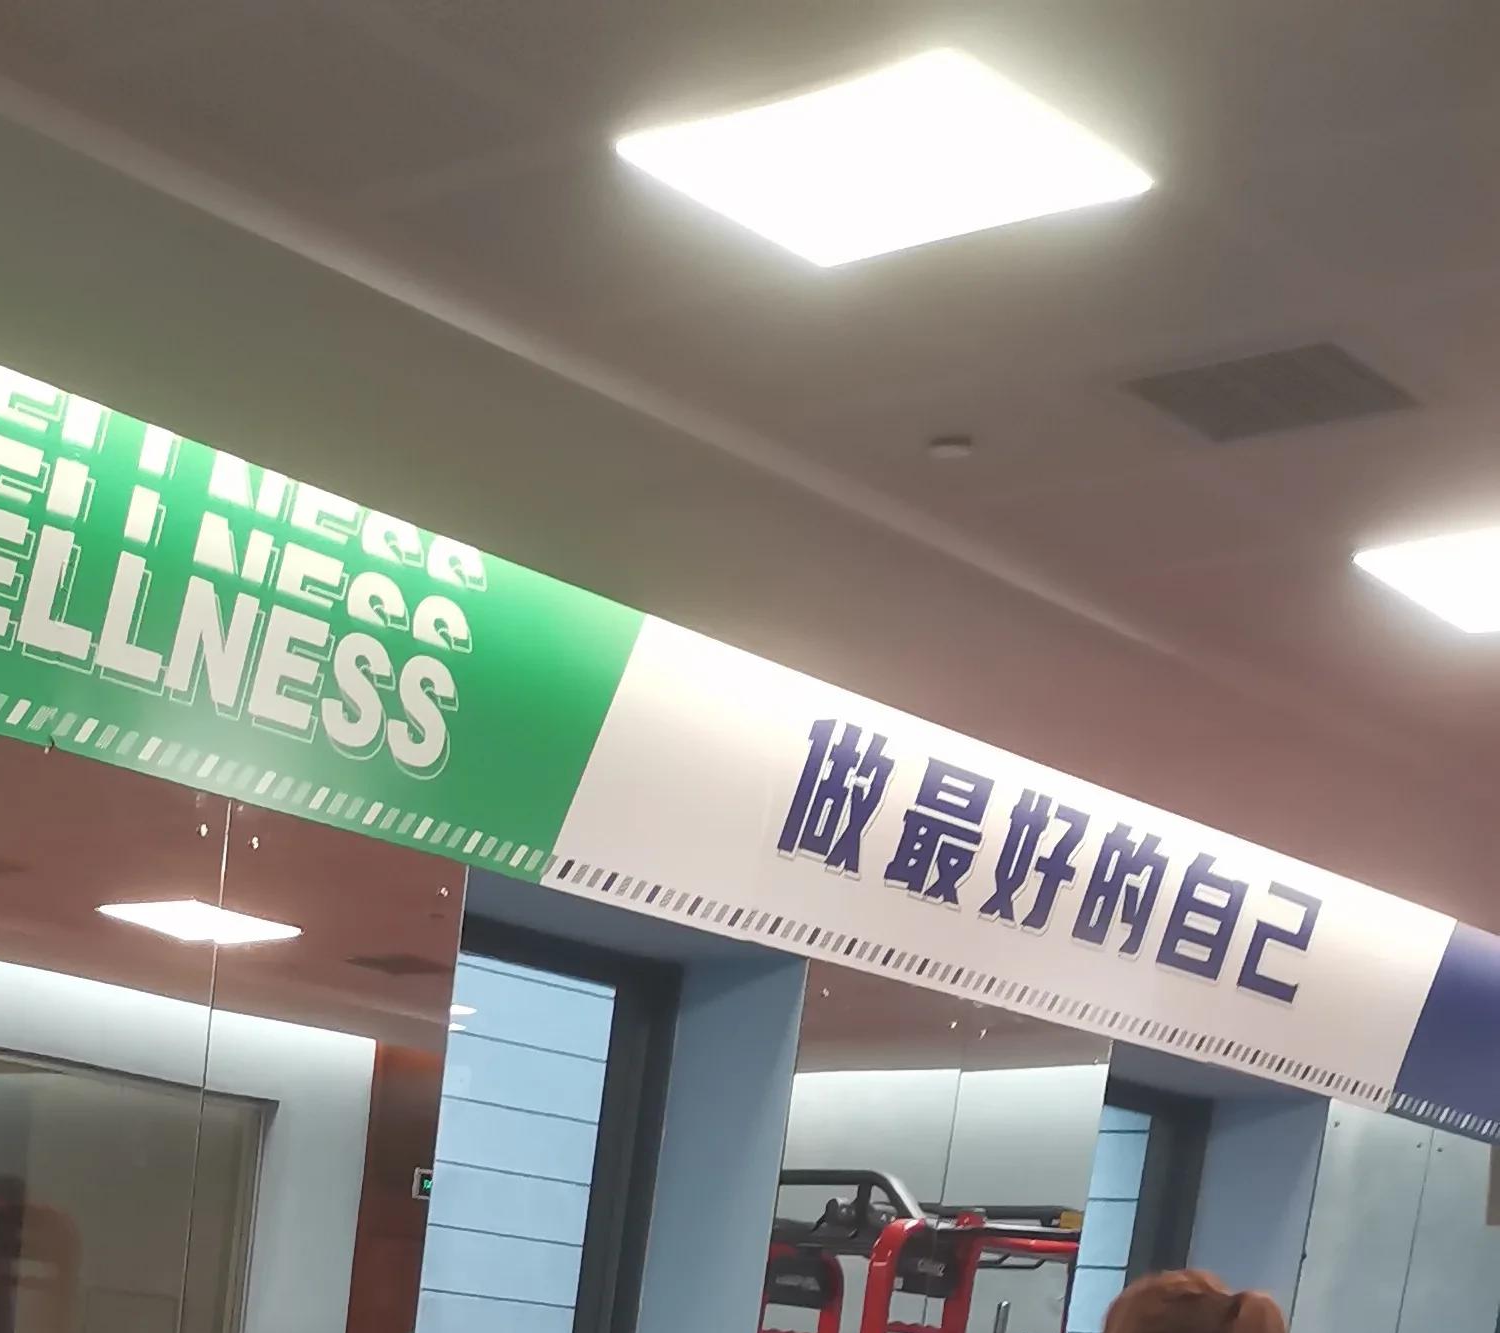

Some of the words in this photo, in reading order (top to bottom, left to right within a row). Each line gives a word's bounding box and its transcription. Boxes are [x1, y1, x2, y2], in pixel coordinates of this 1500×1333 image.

[776, 718, 1323, 1005] 做最好的自己
